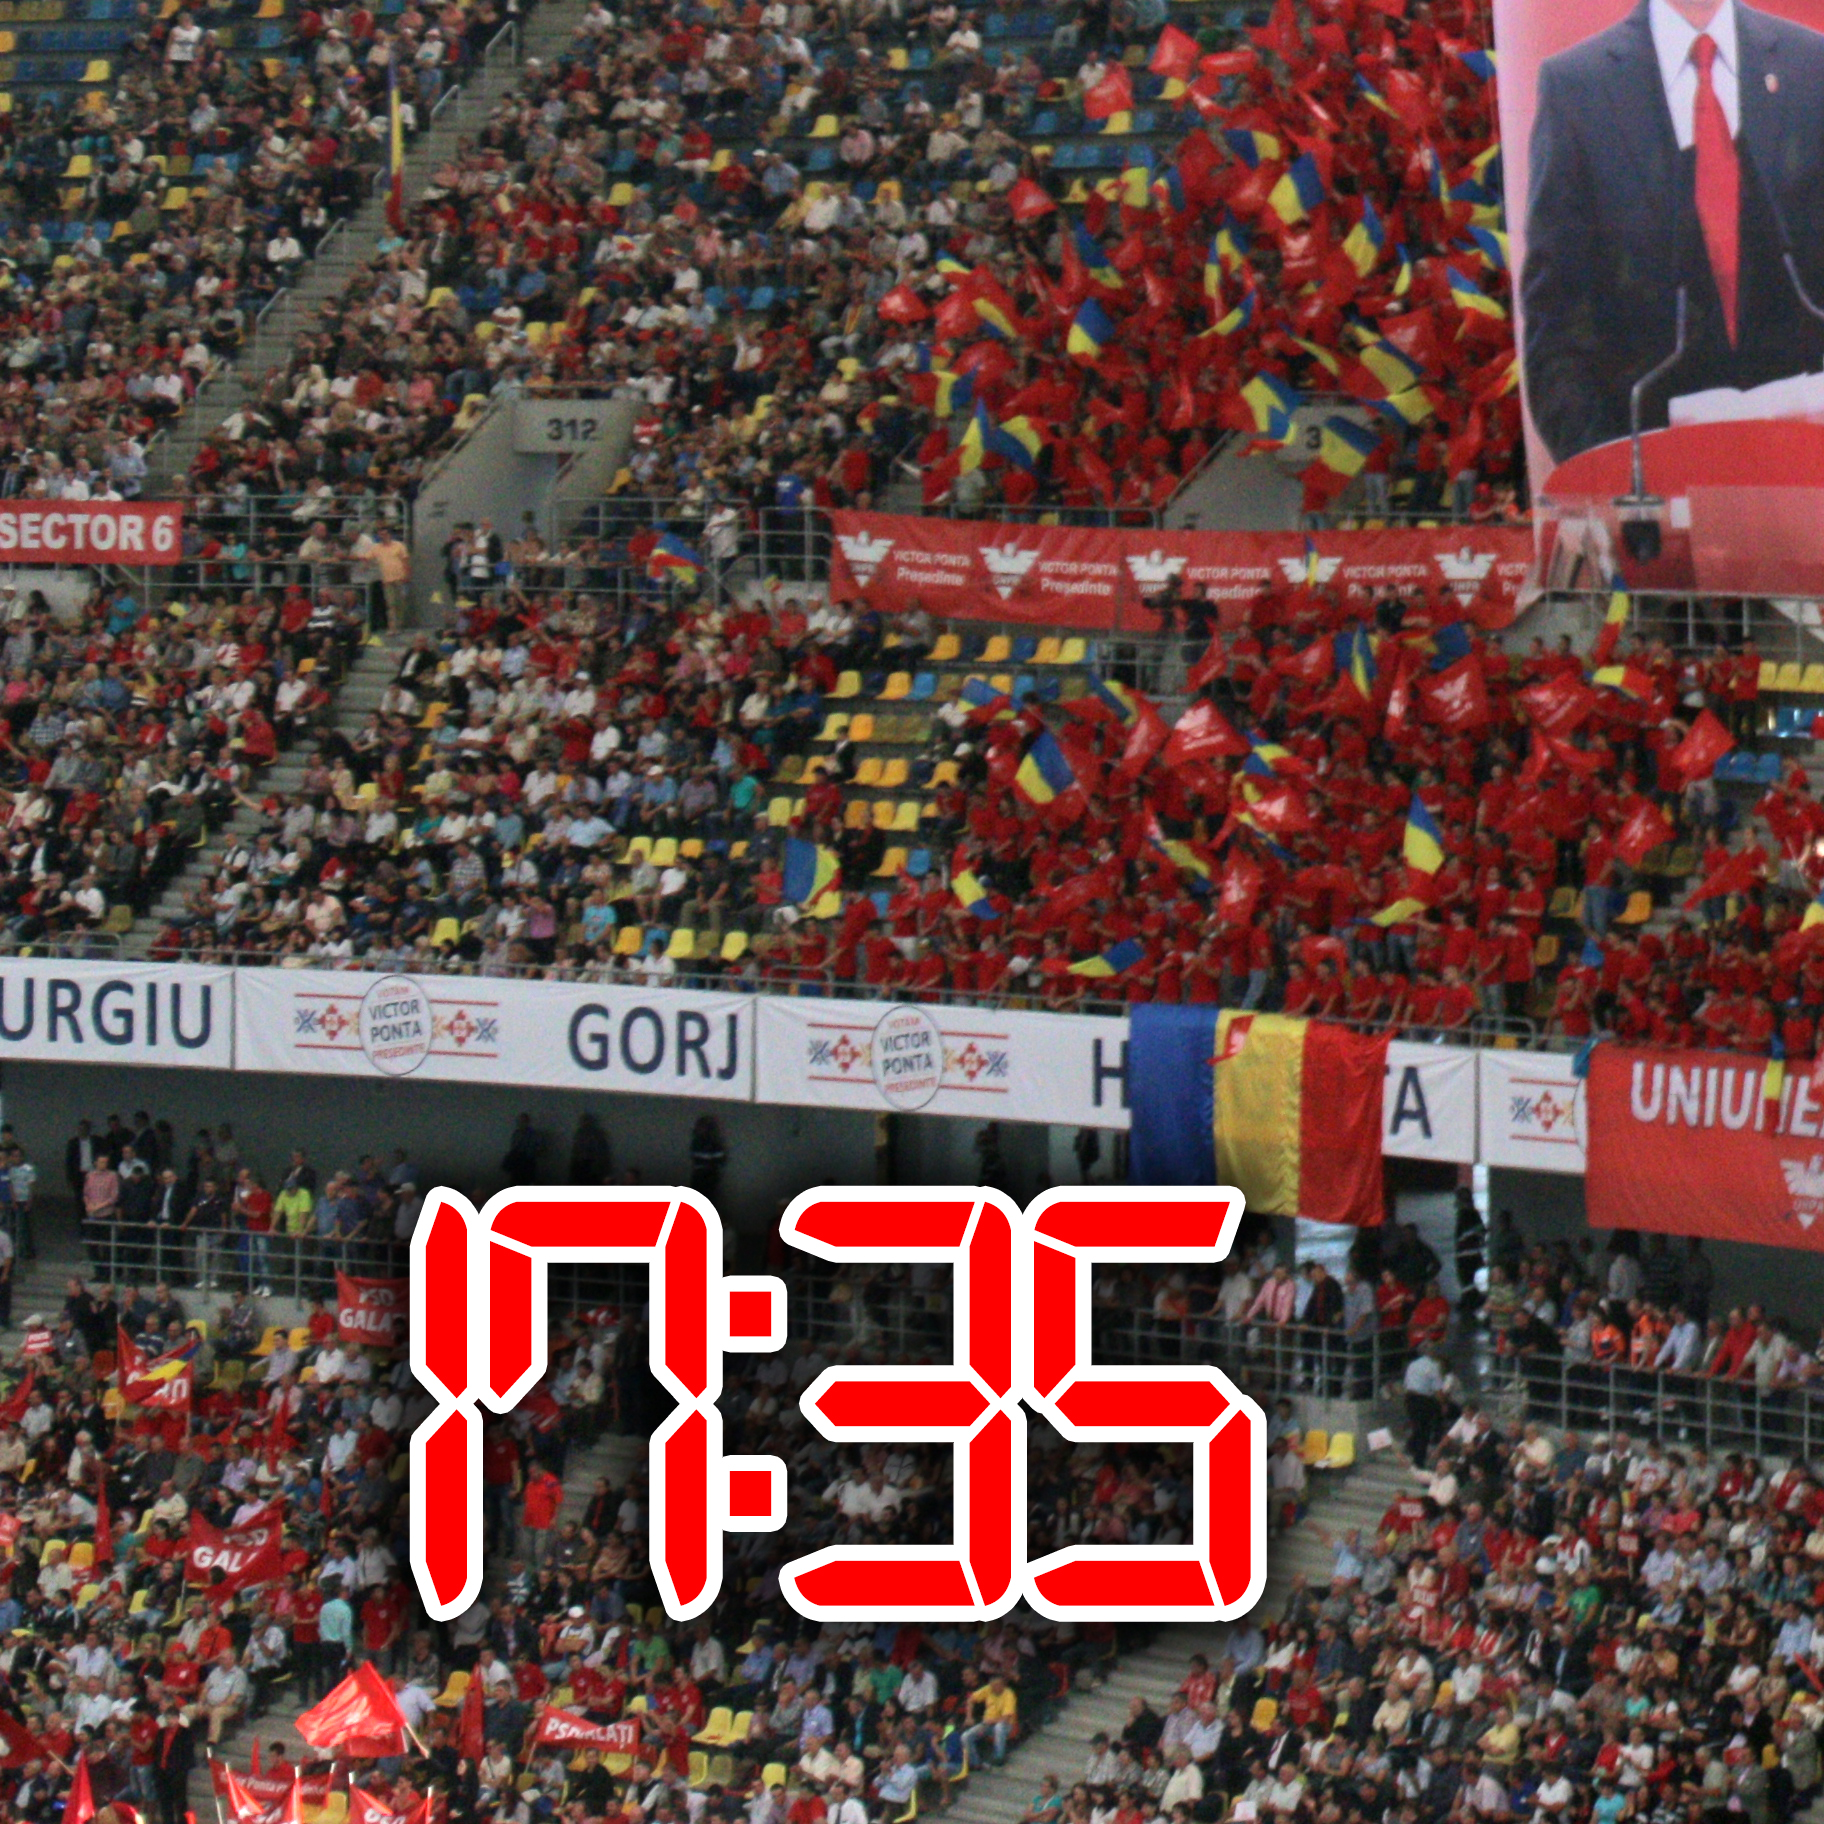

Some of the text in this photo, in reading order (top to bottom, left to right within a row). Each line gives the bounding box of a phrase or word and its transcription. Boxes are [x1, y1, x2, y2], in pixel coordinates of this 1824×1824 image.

[546, 417, 599, 441] 312
[0, 512, 174, 551] SECTOR 6
[0, 976, 212, 1049] URGIU
[368, 999, 420, 1022] VICTOR
[370, 1023, 423, 1044] PONTA
[567, 1002, 740, 1080] GORJ
[881, 1030, 932, 1053] VICTOR
[882, 1052, 934, 1076] PONTA
